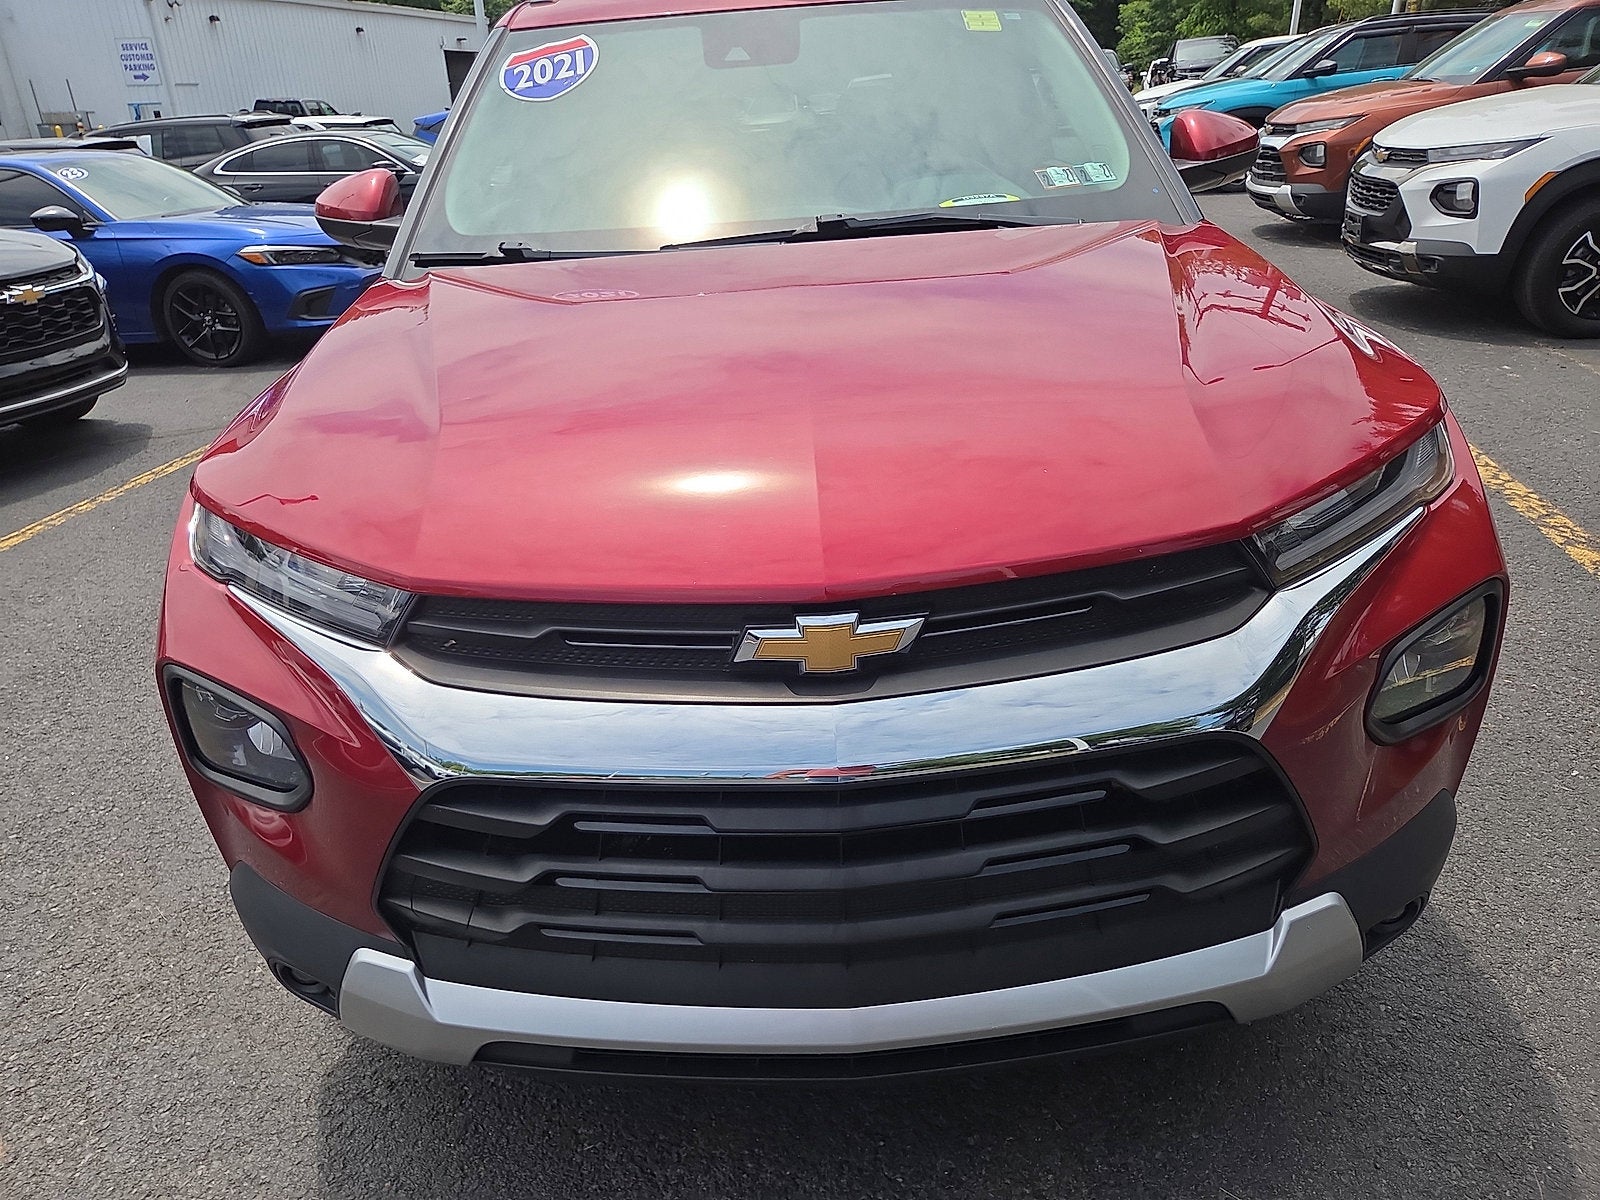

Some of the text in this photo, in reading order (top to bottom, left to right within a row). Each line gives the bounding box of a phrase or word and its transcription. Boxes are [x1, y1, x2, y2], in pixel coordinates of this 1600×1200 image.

[121, 43, 149, 51] SERVICE
[120, 53, 154, 61] CUSTOMER
[123, 63, 156, 72] PARKING
[513, 49, 585, 92] 2021
